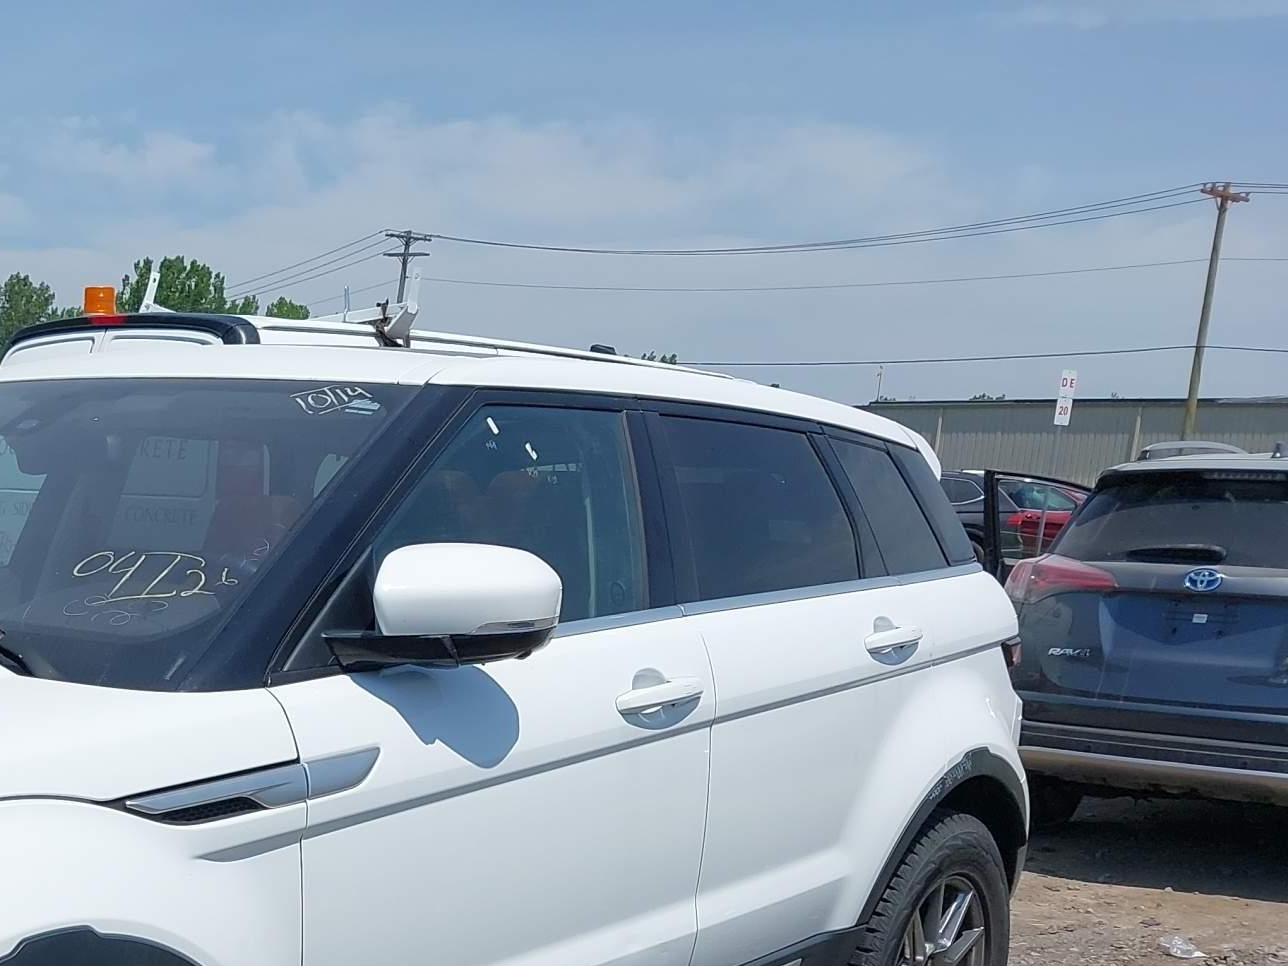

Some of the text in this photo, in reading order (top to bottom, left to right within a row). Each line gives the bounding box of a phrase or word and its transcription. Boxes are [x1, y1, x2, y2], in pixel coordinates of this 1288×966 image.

[1062, 377, 1076, 389] D E
[1058, 406, 1069, 416] 20
